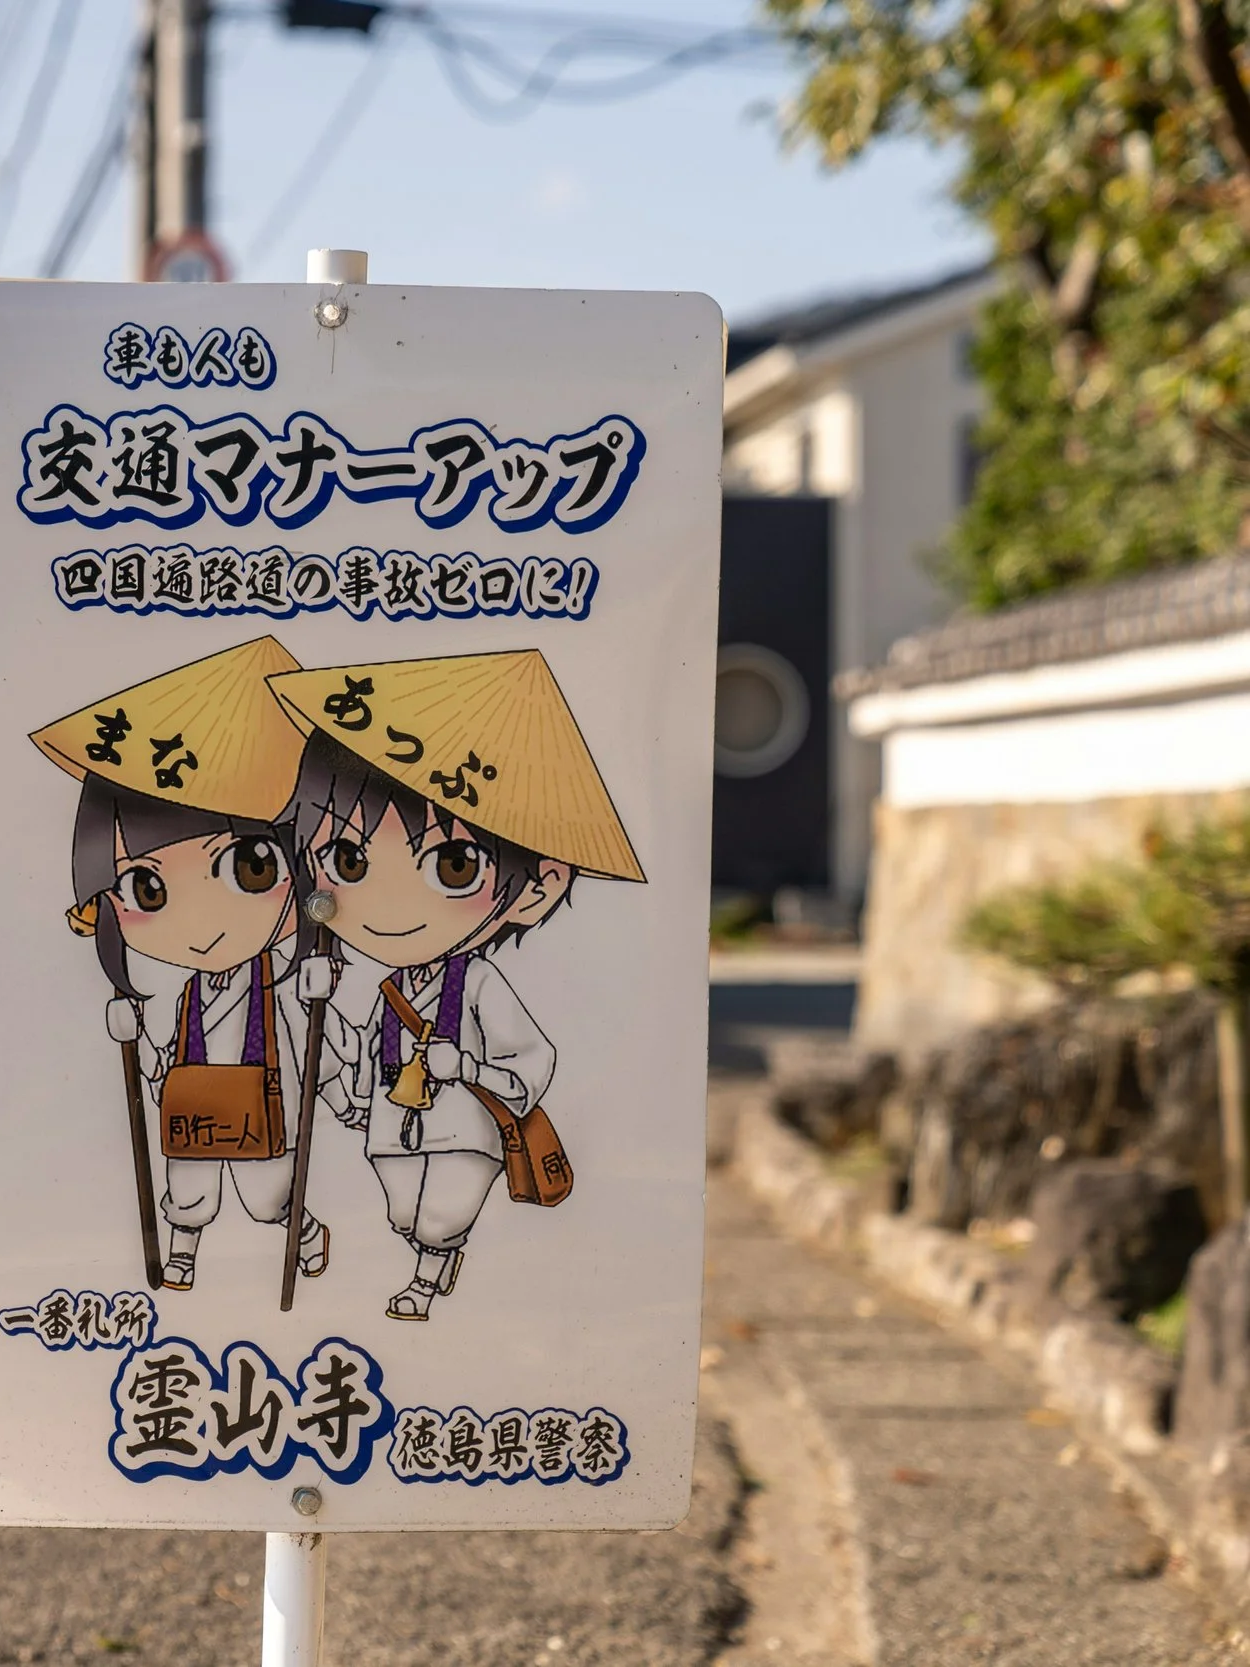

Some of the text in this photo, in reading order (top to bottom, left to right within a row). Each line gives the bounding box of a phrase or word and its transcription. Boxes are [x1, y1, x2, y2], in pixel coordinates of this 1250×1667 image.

[111, 329, 267, 380] 車も人も
[31, 418, 626, 510] 交通マナーアップ
[59, 551, 590, 609] 四国遍路道の事故ゼロに!
[85, 707, 199, 789] まな
[169, 1112, 261, 1151] 同行二人
[541, 1150, 569, 1186] 同
[124, 1352, 372, 1461] 霊山寺
[395, 1414, 619, 1475] 徳島県警察
